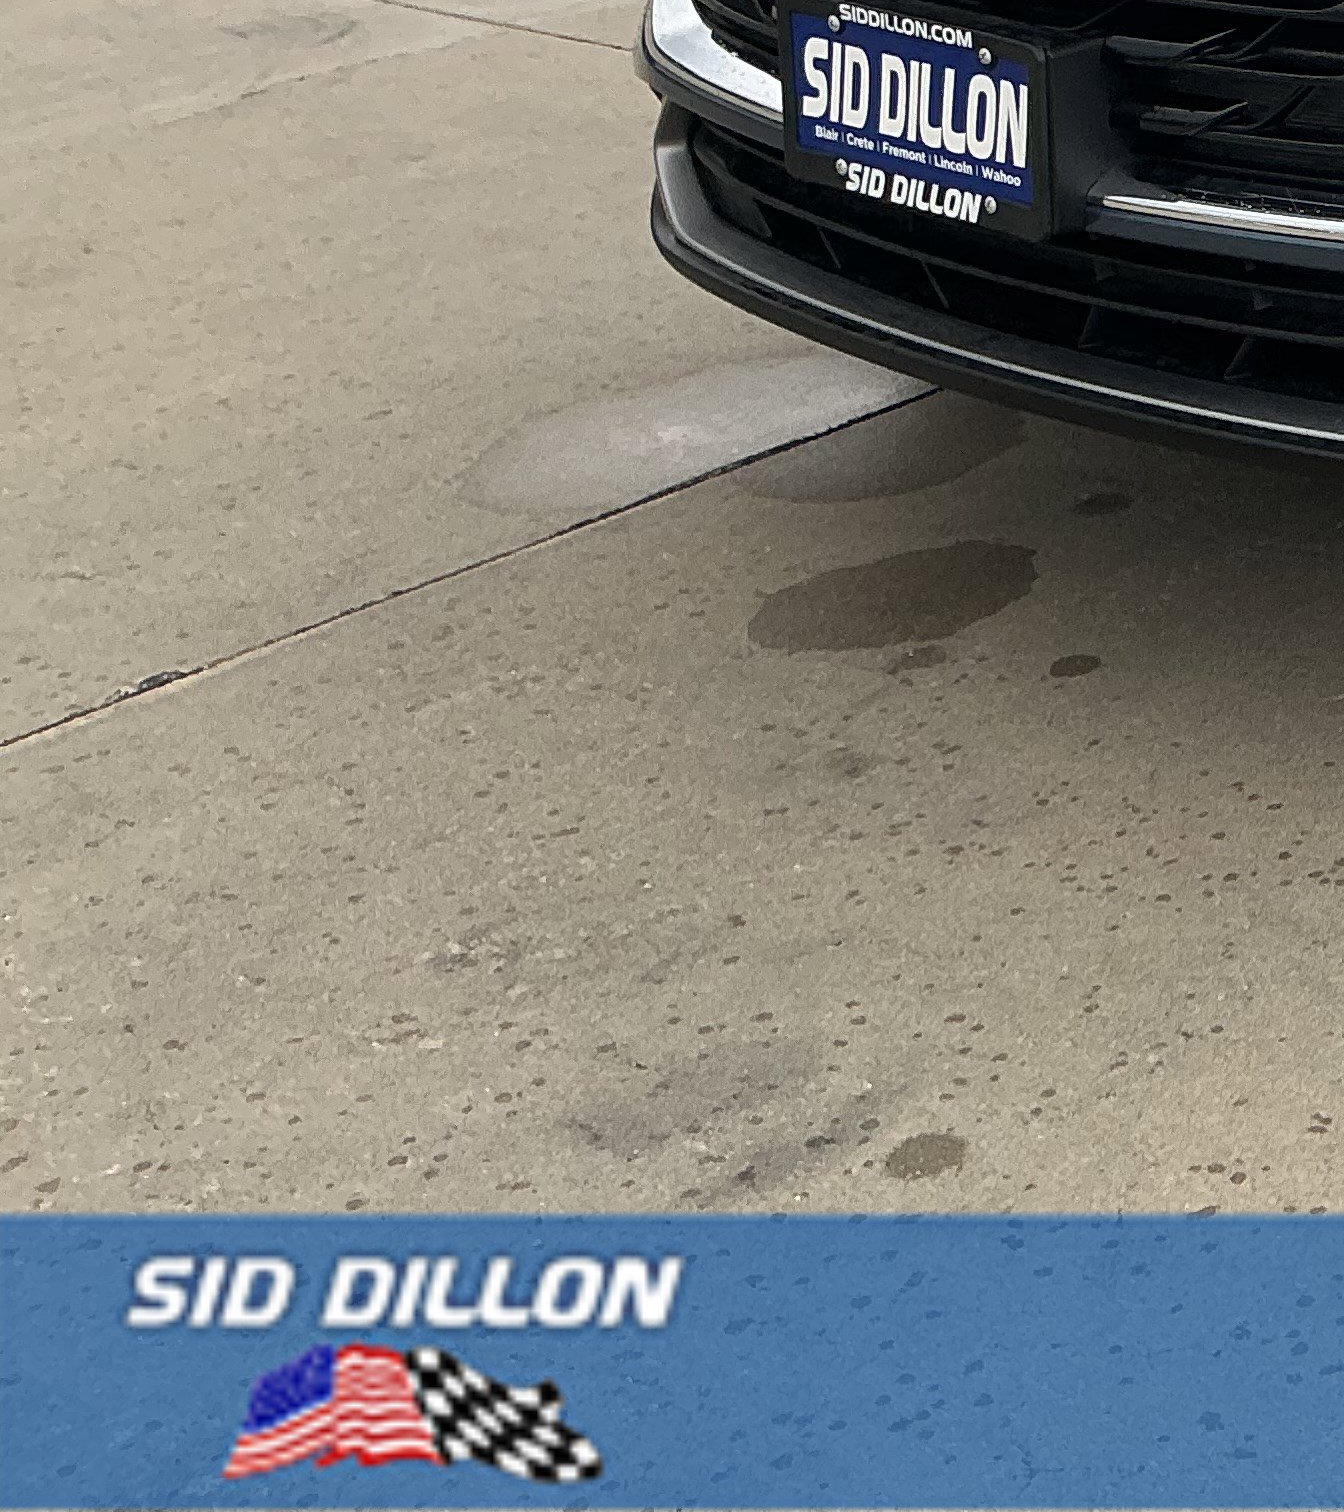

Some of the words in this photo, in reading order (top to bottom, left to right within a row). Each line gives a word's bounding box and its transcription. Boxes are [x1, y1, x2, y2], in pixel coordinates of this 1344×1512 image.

[838, 2, 973, 49] SIDDILLON.COM
[802, 37, 871, 130] SID
[878, 52, 1028, 169] DILLON
[815, 124, 838, 142] Blair
[846, 132, 875, 151] Crete
[882, 141, 927, 165] Fremont
[934, 155, 973, 176] Lincoln
[981, 165, 1021, 187] Wahoo
[845, 162, 885, 199] SID
[890, 175, 982, 224] DILLON
